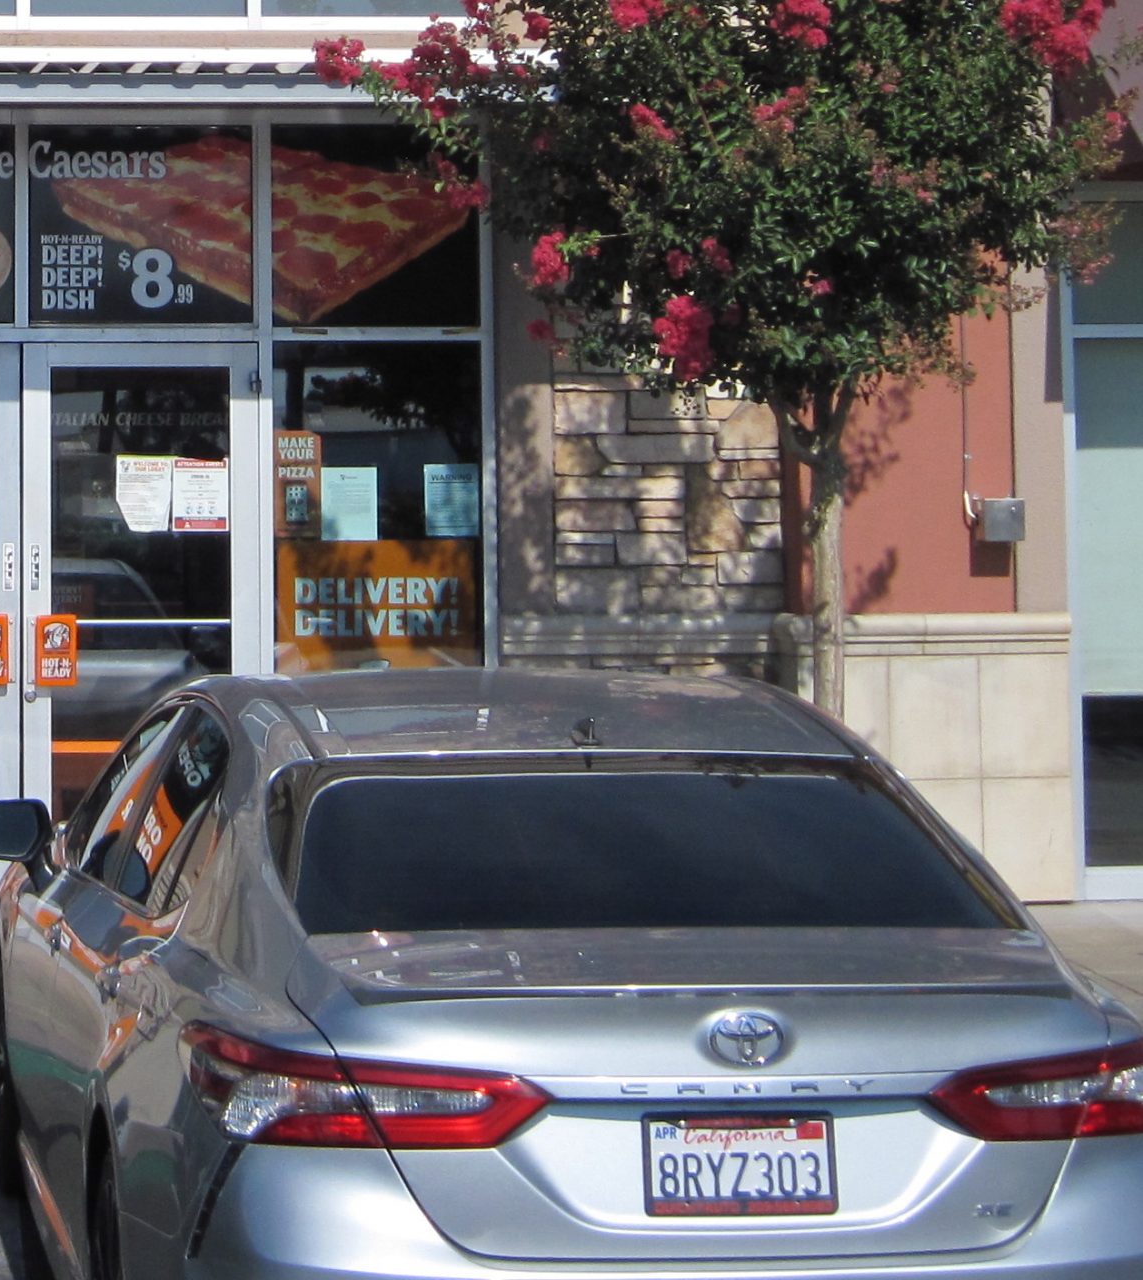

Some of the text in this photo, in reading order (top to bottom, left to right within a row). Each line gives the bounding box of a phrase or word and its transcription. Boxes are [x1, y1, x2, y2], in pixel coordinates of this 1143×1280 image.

[29, 140, 166, 180] Caesars
[41, 235, 103, 245] HOT-N-READY
[41, 246, 104, 266] DEEP!
[41, 268, 104, 288] DEEP!
[41, 290, 95, 310] DISH
[54, 412, 110, 426] TALIAN
[115, 412, 174, 426] CHEESE
[278, 437, 314, 448] MAKE
[278, 448, 314, 460] YOUR
[278, 467, 315, 478] PIZZA
[431, 473, 472, 481] WARNING
[32, 546, 40, 580] PULL
[294, 577, 458, 604] DELIVERY!
[294, 609, 459, 636] DELIVERY!
[41, 657, 72, 668] HOT-N-
[41, 668, 72, 678] READY
[620, 1078, 876, 1095] CAMRY
[654, 1127, 797, 1150] APR California
[658, 1151, 823, 1198] 8RYZ303
